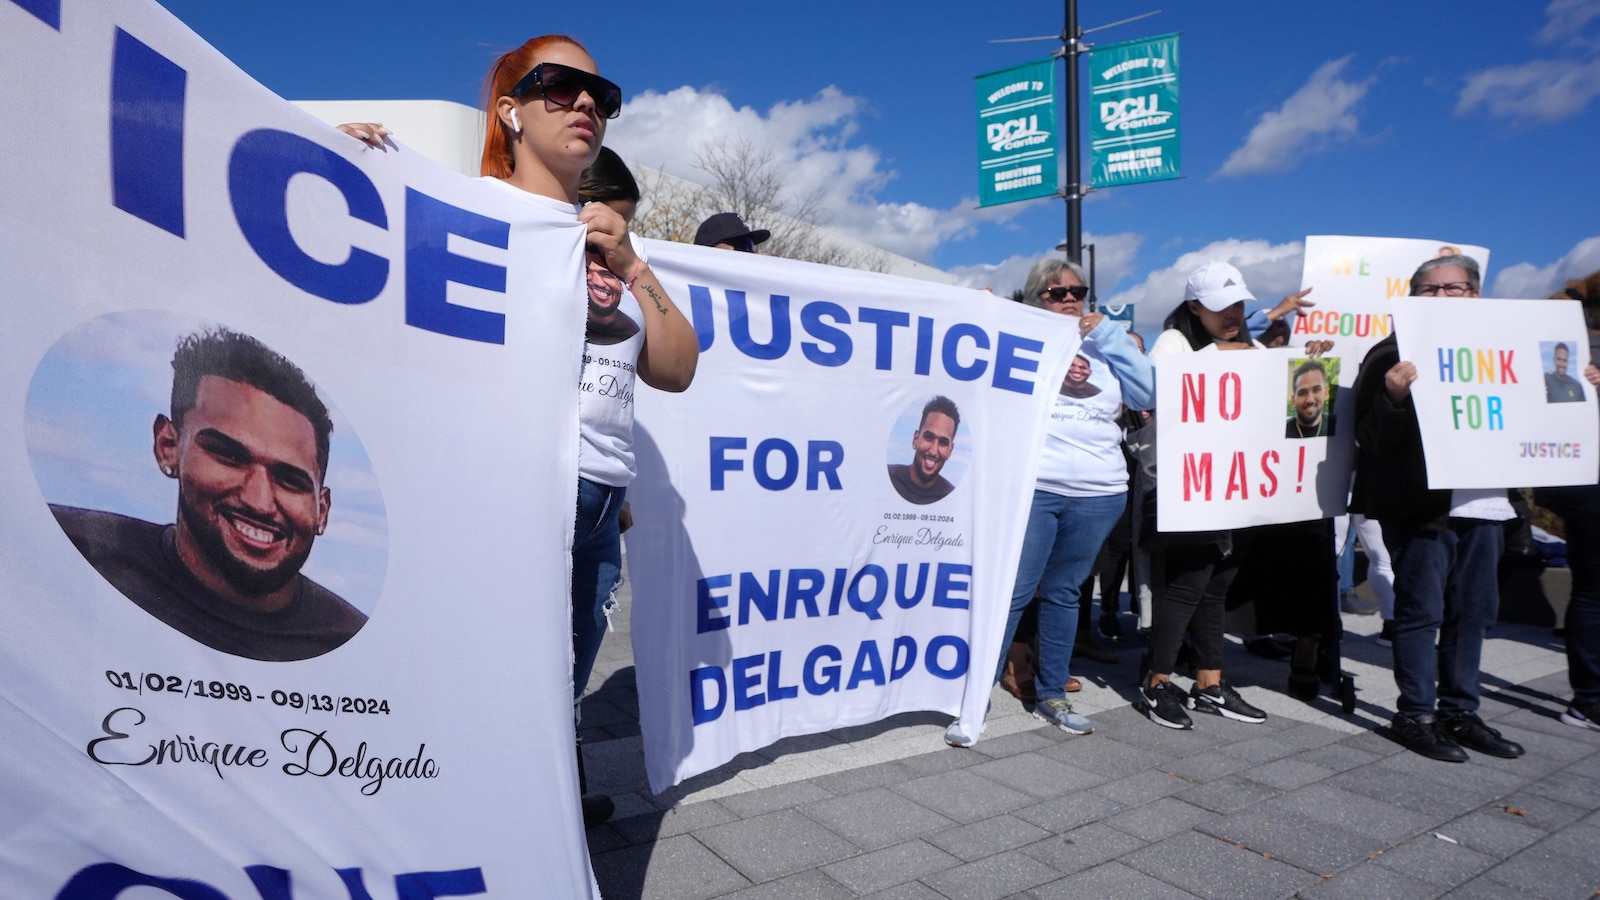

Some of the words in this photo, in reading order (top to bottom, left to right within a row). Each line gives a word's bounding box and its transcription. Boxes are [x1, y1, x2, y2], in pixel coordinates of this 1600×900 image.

[1102, 58, 1149, 80] WELCOME
[1152, 58, 1166, 68] TO
[988, 81, 1029, 104] WELCOME
[1032, 81, 1043, 91] TO
[1101, 94, 1158, 123] DCU
[1119, 114, 1170, 130] center
[987, 115, 1038, 144] DCU
[1004, 134, 1049, 151] center
[1108, 146, 1162, 162] DOWNTOWN
[1108, 157, 1162, 173] WORCESTER
[10, 0, 511, 345] ICE
[995, 164, 1042, 181] DOWNTOWN
[995, 175, 1042, 192] WORCESTER
[1331, 252, 1372, 276] WE
[688, 284, 1045, 395] JUSTICE
[1438, 347, 1518, 384] HONK
[1181, 372, 1242, 423] NO
[1451, 394, 1504, 431] FOR
[709, 436, 845, 491] FOR
[1519, 442, 1581, 459] JUSTICE
[873, 525, 913, 549] Enrique
[915, 527, 965, 551] Delgado
[697, 563, 972, 635] ENRIQUE
[105, 670, 252, 702] 01/02/1999
[271, 690, 391, 716] 09/13/2024
[689, 635, 970, 727] DELGADO
[87, 707, 269, 780] Enrique
[280, 728, 440, 796] Delgado
